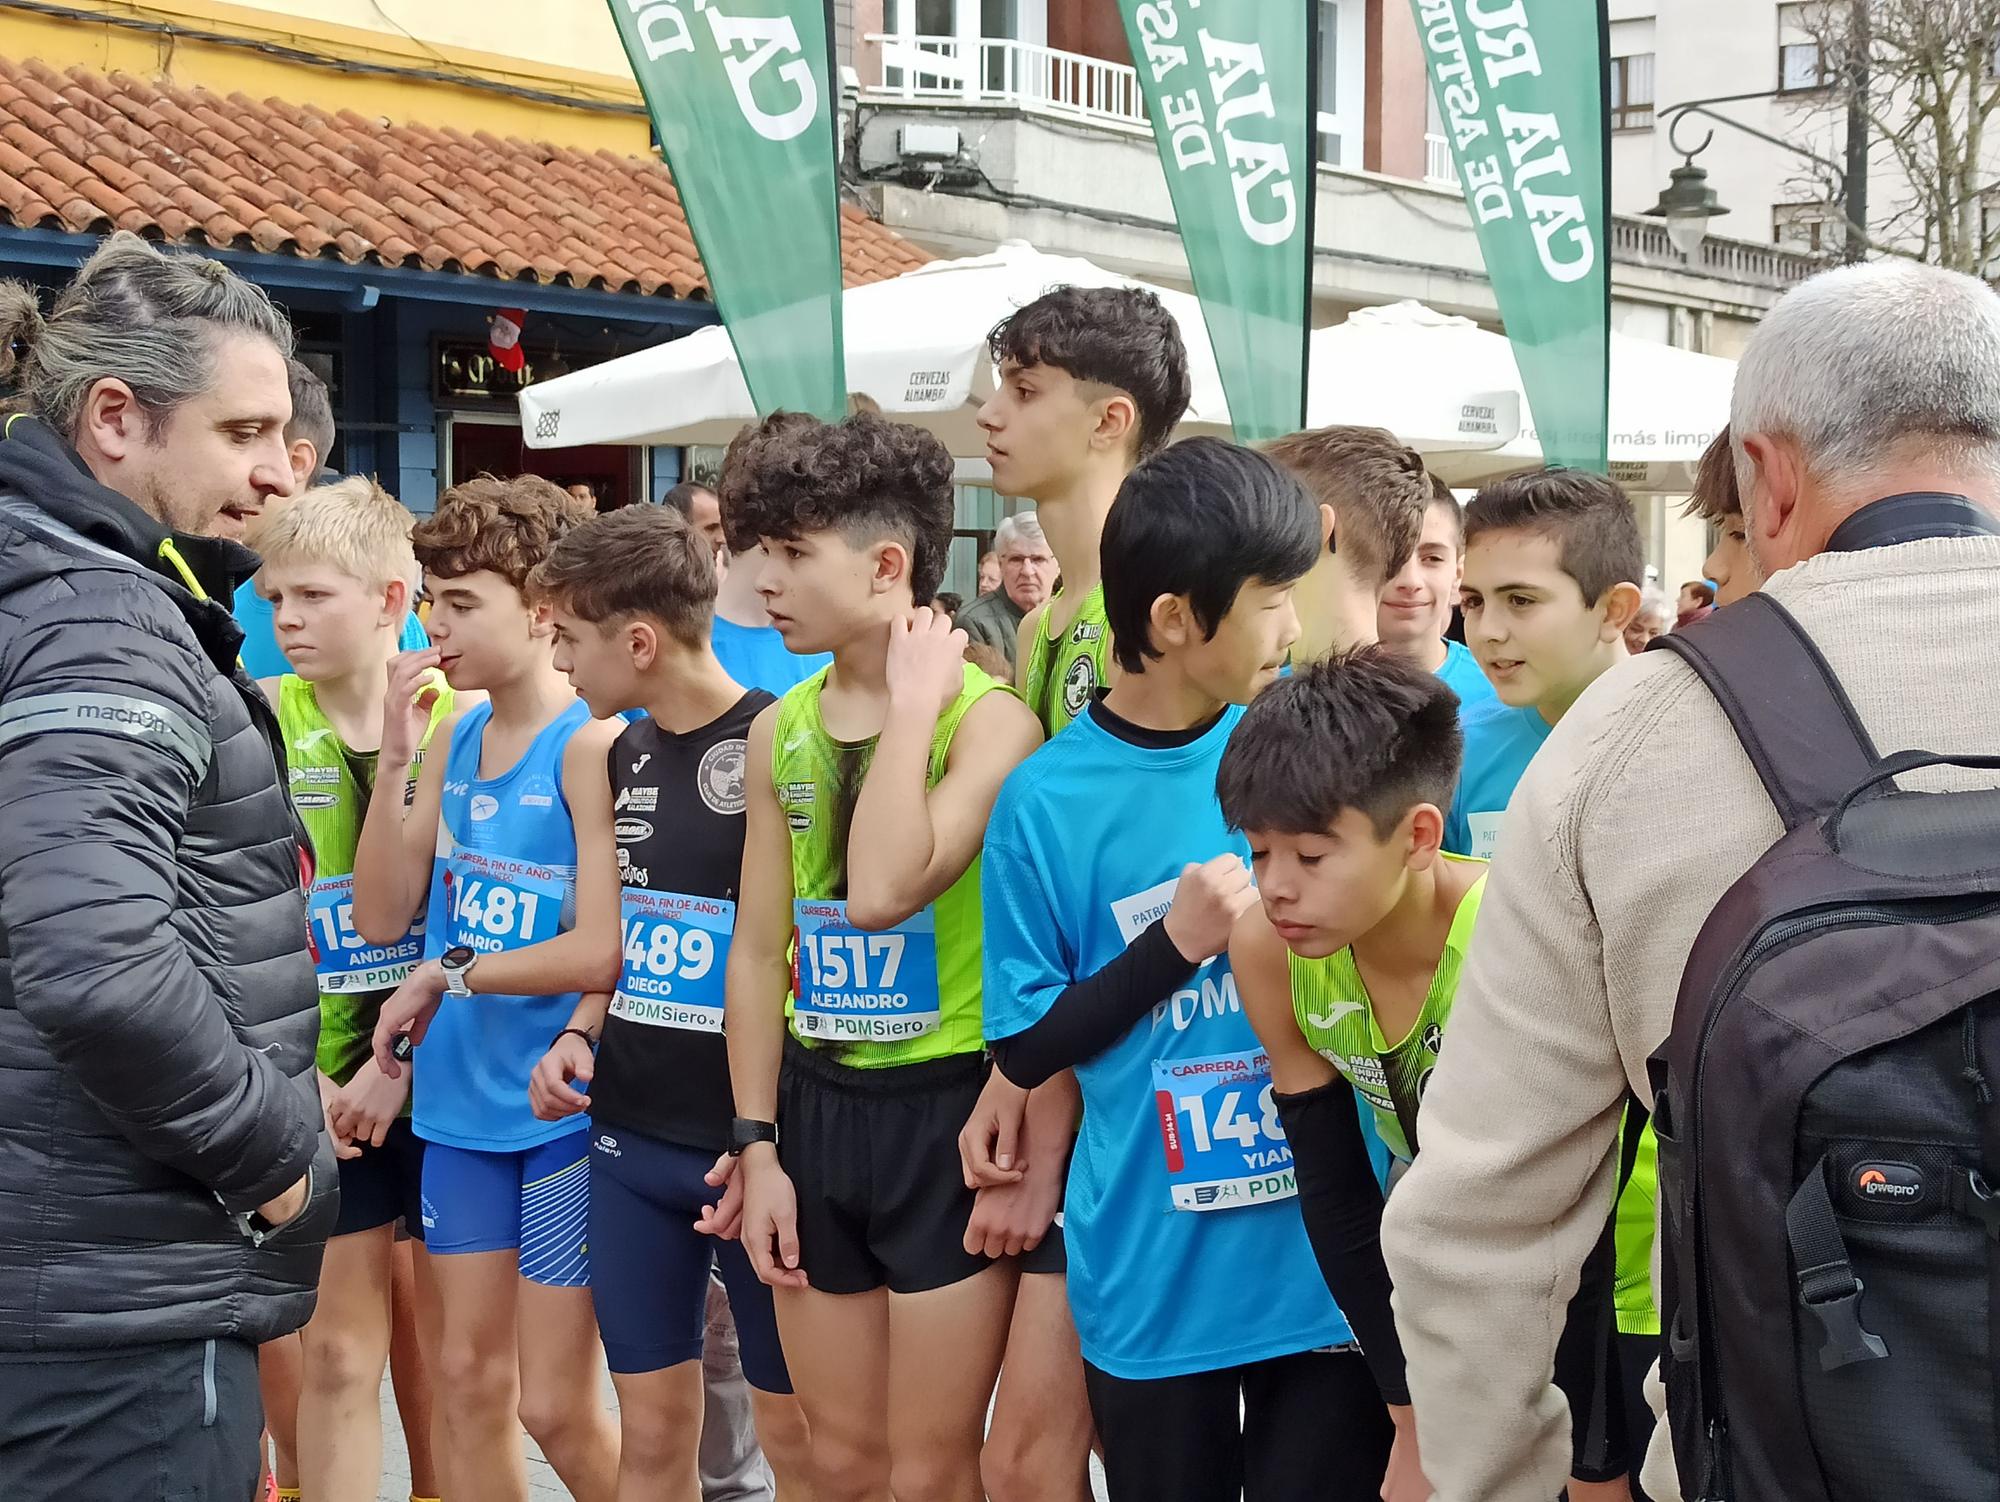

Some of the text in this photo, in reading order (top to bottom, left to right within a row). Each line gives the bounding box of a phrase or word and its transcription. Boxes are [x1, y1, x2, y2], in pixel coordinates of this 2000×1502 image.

[909, 371, 951, 385] CERVEZAS
[1612, 430, 1657, 446] más
[509, 862, 524, 874] DE
[453, 875, 539, 940] 1481
[658, 897, 674, 909] FIN
[677, 899, 692, 911] DE
[694, 901, 720, 916] AÑO
[457, 930, 504, 953] MARIO
[349, 941, 418, 966] ANDRES
[805, 934, 906, 988] 1517
[627, 976, 672, 996] DIEGO
[811, 990, 909, 1009] ALEJANDRO
[627, 1000, 708, 1024] PDMSiero
[834, 1018, 923, 1036] PDMSiero
[1171, 1060, 1249, 1077] CARRERA
